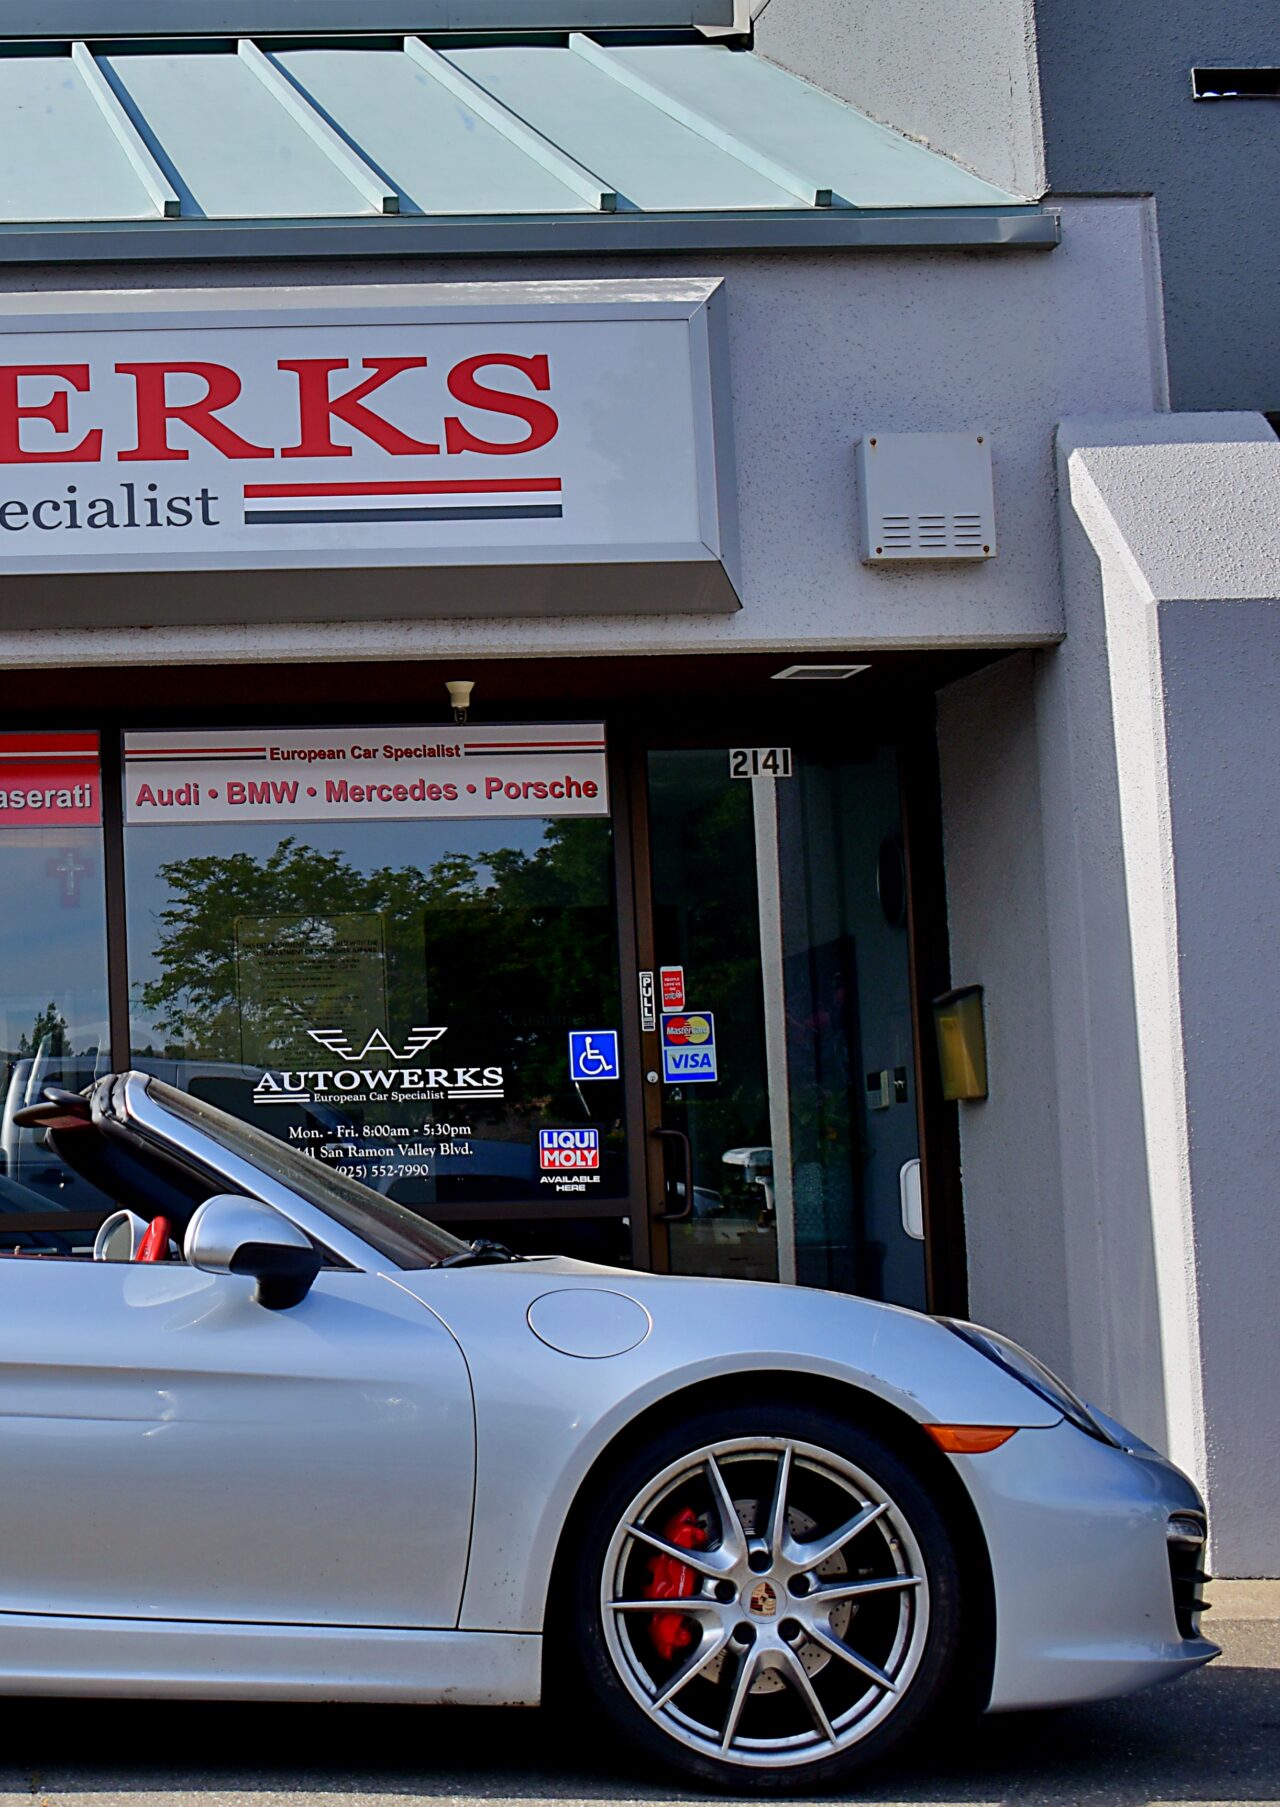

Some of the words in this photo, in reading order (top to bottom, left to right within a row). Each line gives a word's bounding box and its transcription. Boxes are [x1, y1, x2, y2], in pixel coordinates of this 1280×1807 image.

[270, 747, 346, 763] European
[350, 746, 379, 760] Car
[383, 744, 461, 761] Specialist
[732, 749, 790, 776] 2141
[135, 782, 200, 806] Audi
[226, 780, 299, 805] BMW
[325, 778, 458, 802] Mercedes
[485, 775, 598, 800] Porsche
[642, 977, 653, 1017] PULL
[670, 1053, 712, 1069] VISA
[253, 1066, 504, 1092] AUTOWERKS
[314, 1092, 367, 1103] European
[369, 1091, 390, 1101] Car
[391, 1090, 445, 1102] Specialist
[288, 1126, 324, 1139] Mon.
[336, 1125, 359, 1138] Fri.
[362, 1124, 410, 1137] 8:00am
[423, 1123, 472, 1138] 5:30pm
[543, 1131, 595, 1149] LIQUI
[320, 1145, 344, 1158] San
[348, 1145, 394, 1158] Ramon
[397, 1143, 436, 1158] Valley
[439, 1142, 473, 1156] Blvd.
[544, 1150, 597, 1167] MOLY
[371, 1164, 429, 1177] 552-7990
[540, 1175, 600, 1183] AVAILABLE
[556, 1184, 586, 1192] HERE
